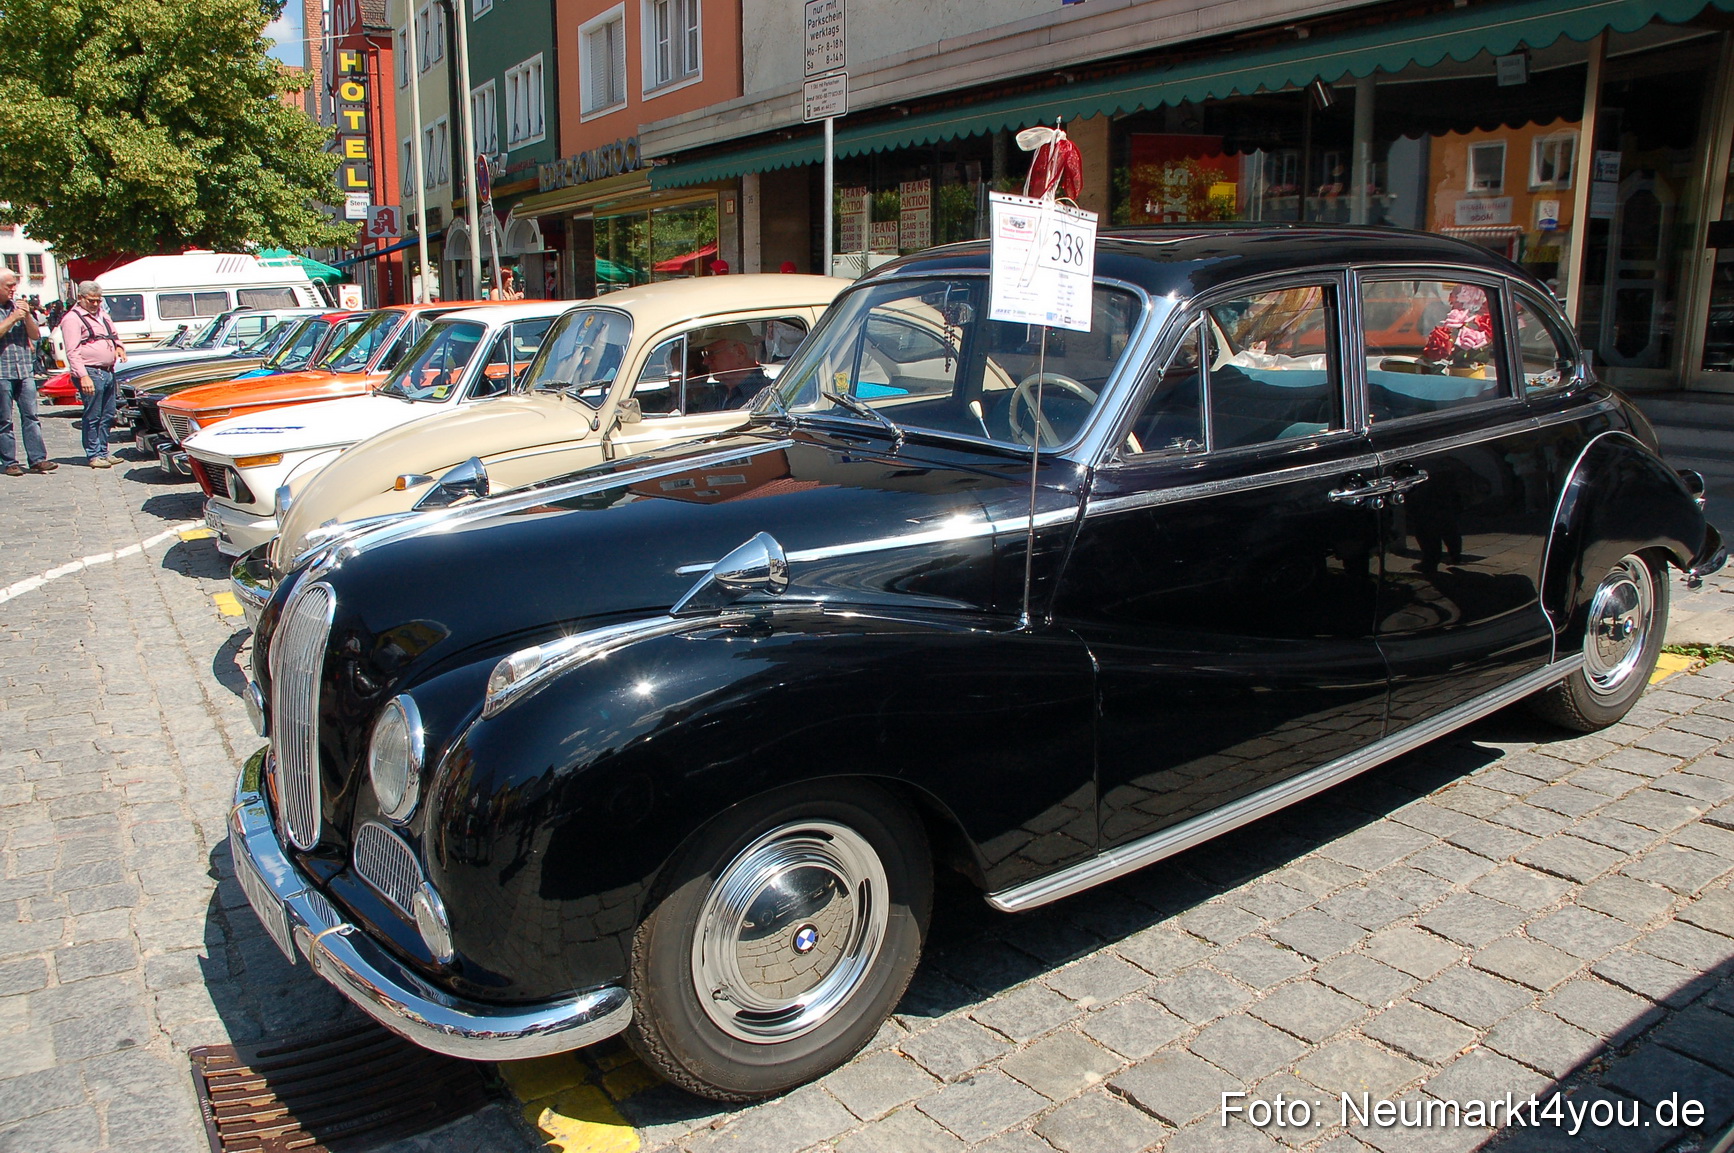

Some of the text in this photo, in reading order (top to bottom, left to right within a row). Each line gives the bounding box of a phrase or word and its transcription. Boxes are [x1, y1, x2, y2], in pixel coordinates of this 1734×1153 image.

[812, 0, 837, 15] nur mit
[807, 10, 843, 30] Parkschein
[809, 24, 840, 41] werktags
[806, 45, 824, 58] Mo-Fr
[806, 60, 814, 71] Sa
[339, 52, 369, 187] HOTEL
[841, 186, 866, 199] JEANS
[901, 180, 929, 194] JEANS
[841, 200, 866, 211] AKTION
[901, 195, 929, 208] AKTION
[841, 216, 855, 224] JEANS
[901, 212, 917, 221] JEANS
[841, 225, 855, 233] JEANS
[871, 222, 897, 234] JEANS
[901, 222, 917, 231] JEANS
[841, 233, 855, 241] JEANS
[870, 235, 897, 248] AKTION
[901, 231, 917, 240] JEANS
[1051, 230, 1084, 267] 338
